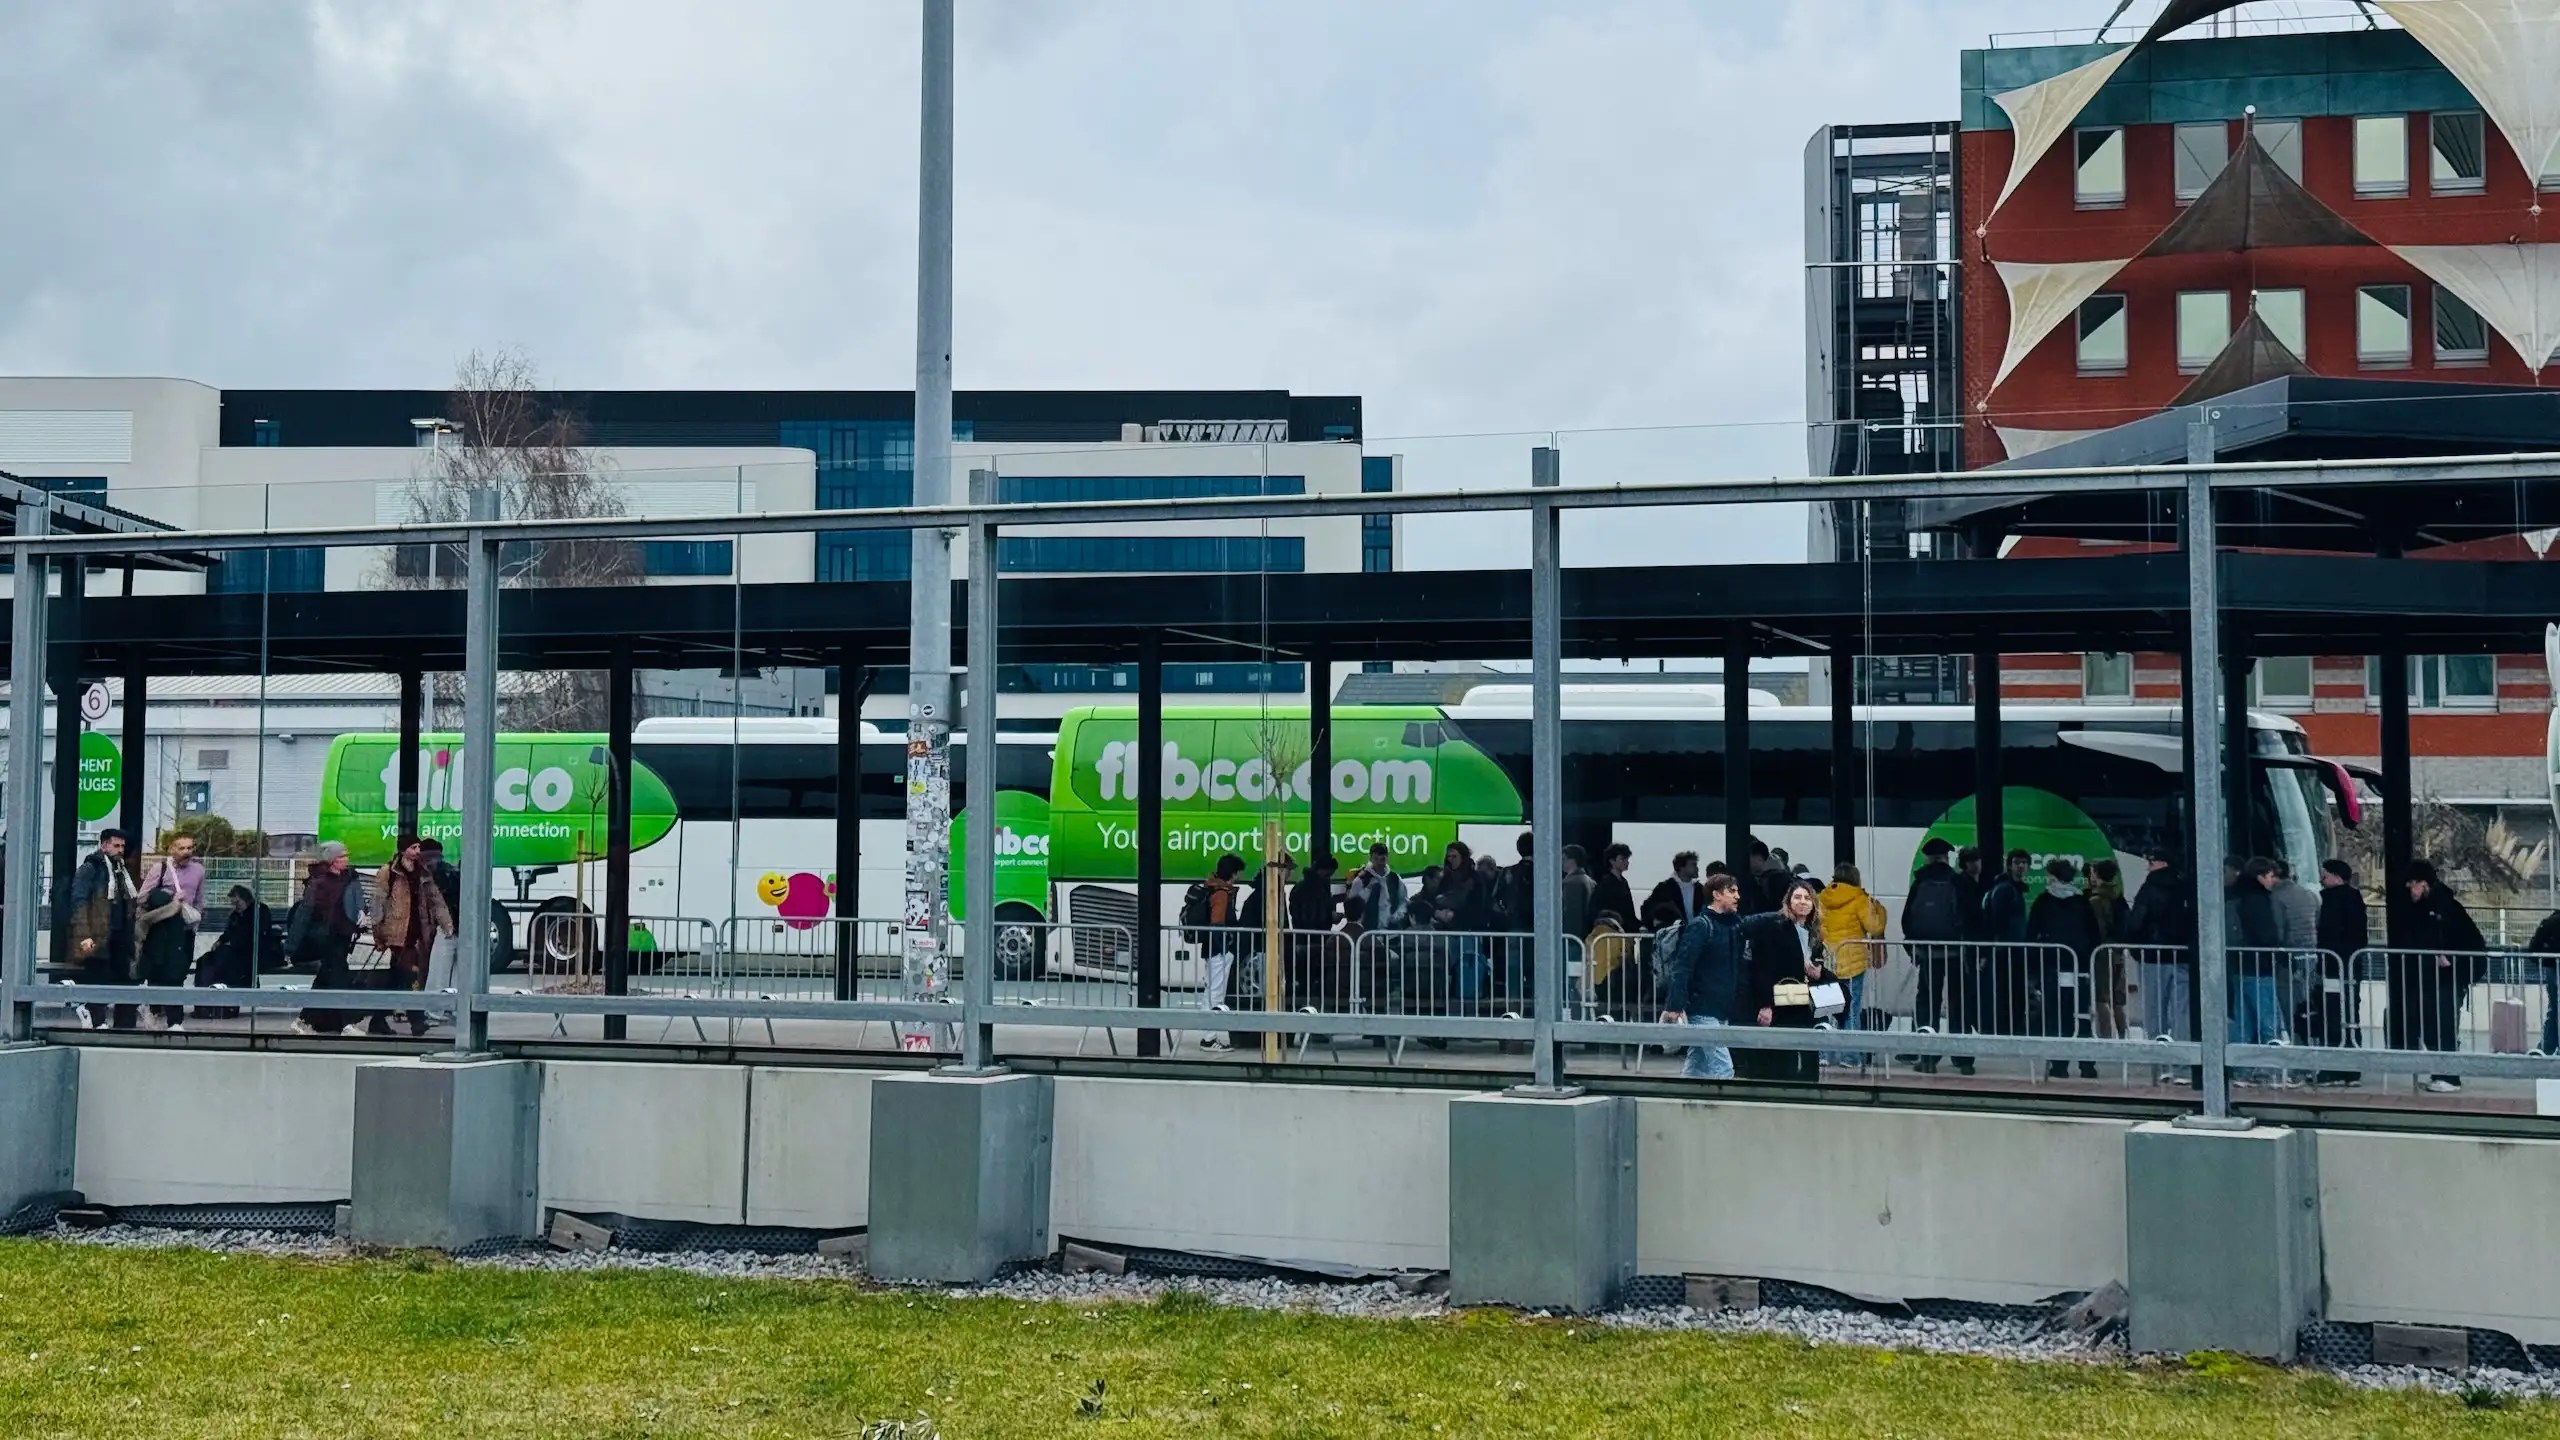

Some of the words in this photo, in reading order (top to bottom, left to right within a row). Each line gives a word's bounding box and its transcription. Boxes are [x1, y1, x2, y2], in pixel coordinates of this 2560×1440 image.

[88, 689, 101, 711] 6
[79, 758, 113, 772] HENT
[1095, 741, 1432, 804] flbco.com
[79, 777, 116, 792] RUGES
[421, 820, 463, 841] airpo
[493, 821, 570, 838] onnection
[994, 826, 1050, 856] ibco
[1167, 823, 1263, 857] airport
[1277, 826, 1428, 855] oection
